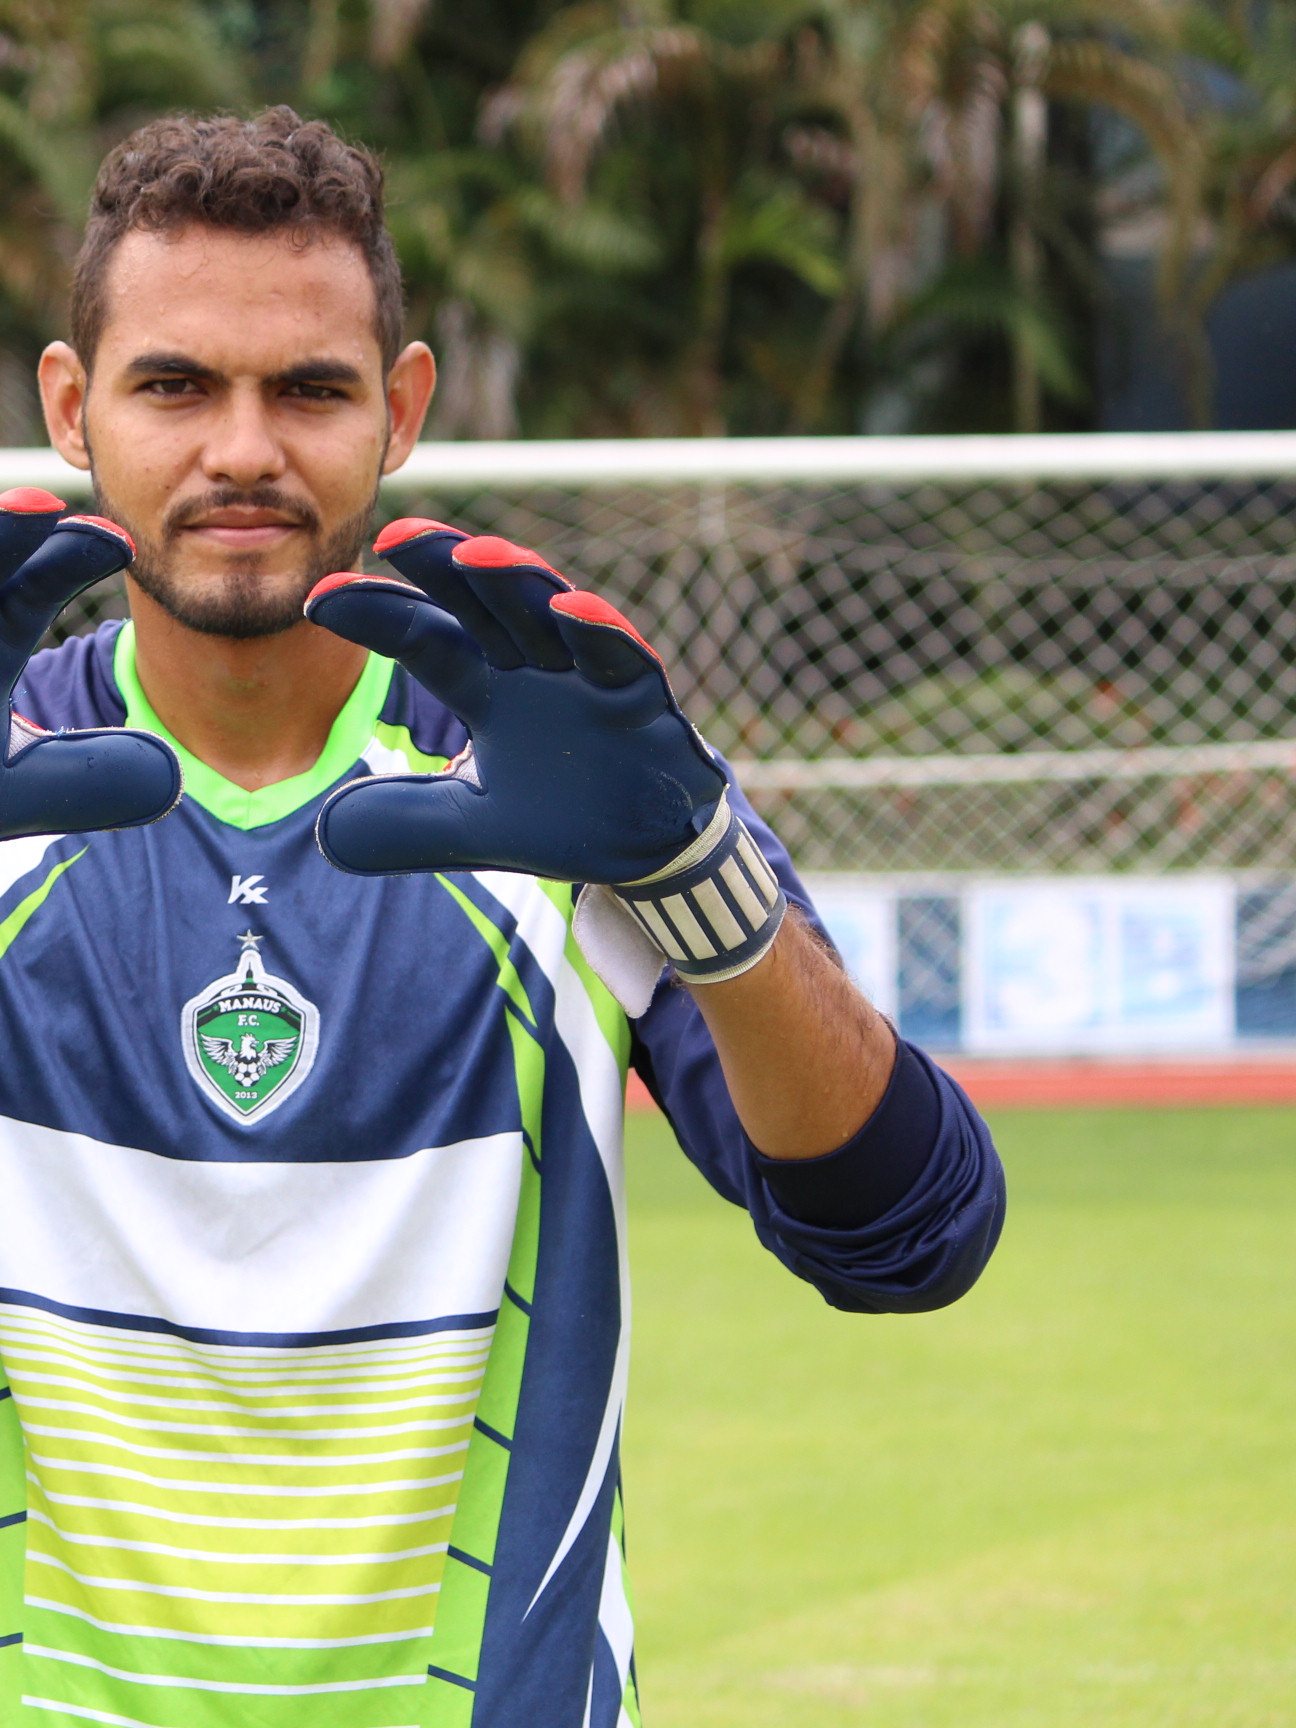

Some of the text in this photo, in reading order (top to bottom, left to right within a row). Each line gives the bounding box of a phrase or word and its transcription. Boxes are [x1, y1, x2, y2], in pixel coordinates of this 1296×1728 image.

[218, 999, 282, 1013] MANAUS
[237, 1014, 260, 1027] F.C.
[234, 1091, 258, 1099] 2013
